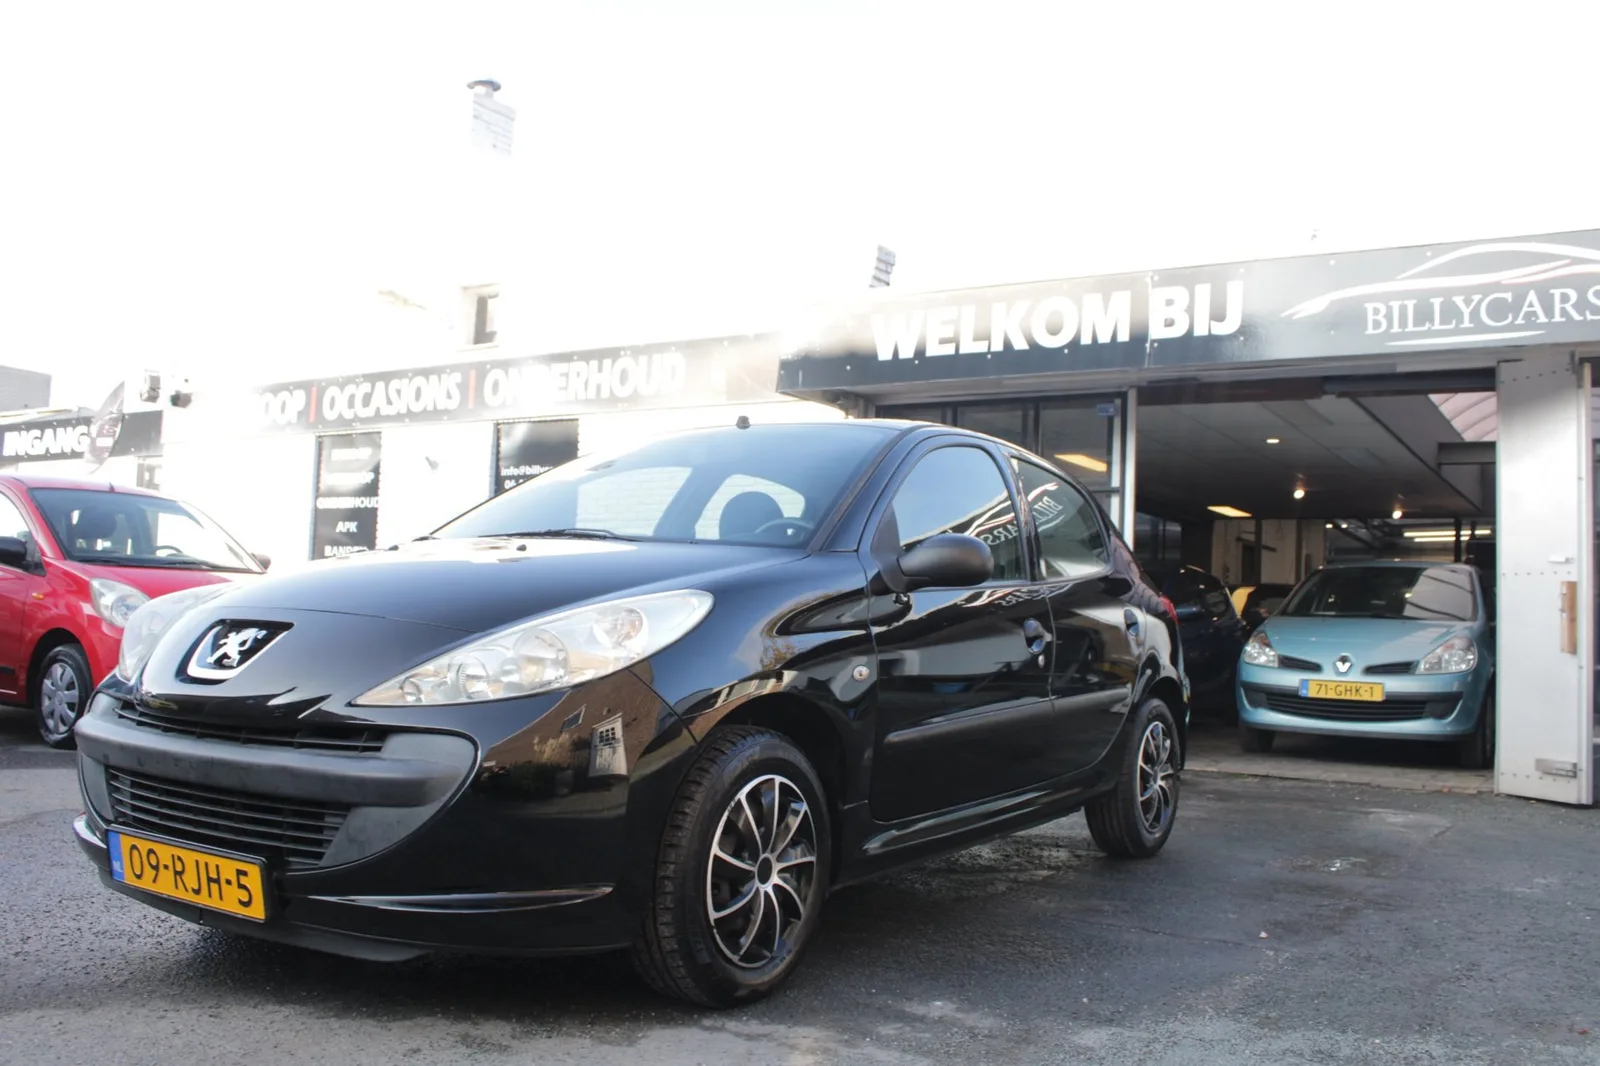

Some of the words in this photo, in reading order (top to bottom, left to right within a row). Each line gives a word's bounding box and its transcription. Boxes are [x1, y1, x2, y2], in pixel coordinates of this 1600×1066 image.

[871, 289, 1131, 361] WELKOM
[1149, 280, 1244, 339] BIJ
[1363, 287, 1600, 335] BILLYCARS
[252, 389, 307, 425] OOP
[322, 371, 462, 421] OCCASIONS
[483, 352, 687, 408] ONERHOUD
[2, 425, 91, 457] INGANG
[335, 520, 358, 533] APK
[1315, 683, 1375, 699] 71-GHK-1
[128, 843, 254, 909] 09-RJH-5
